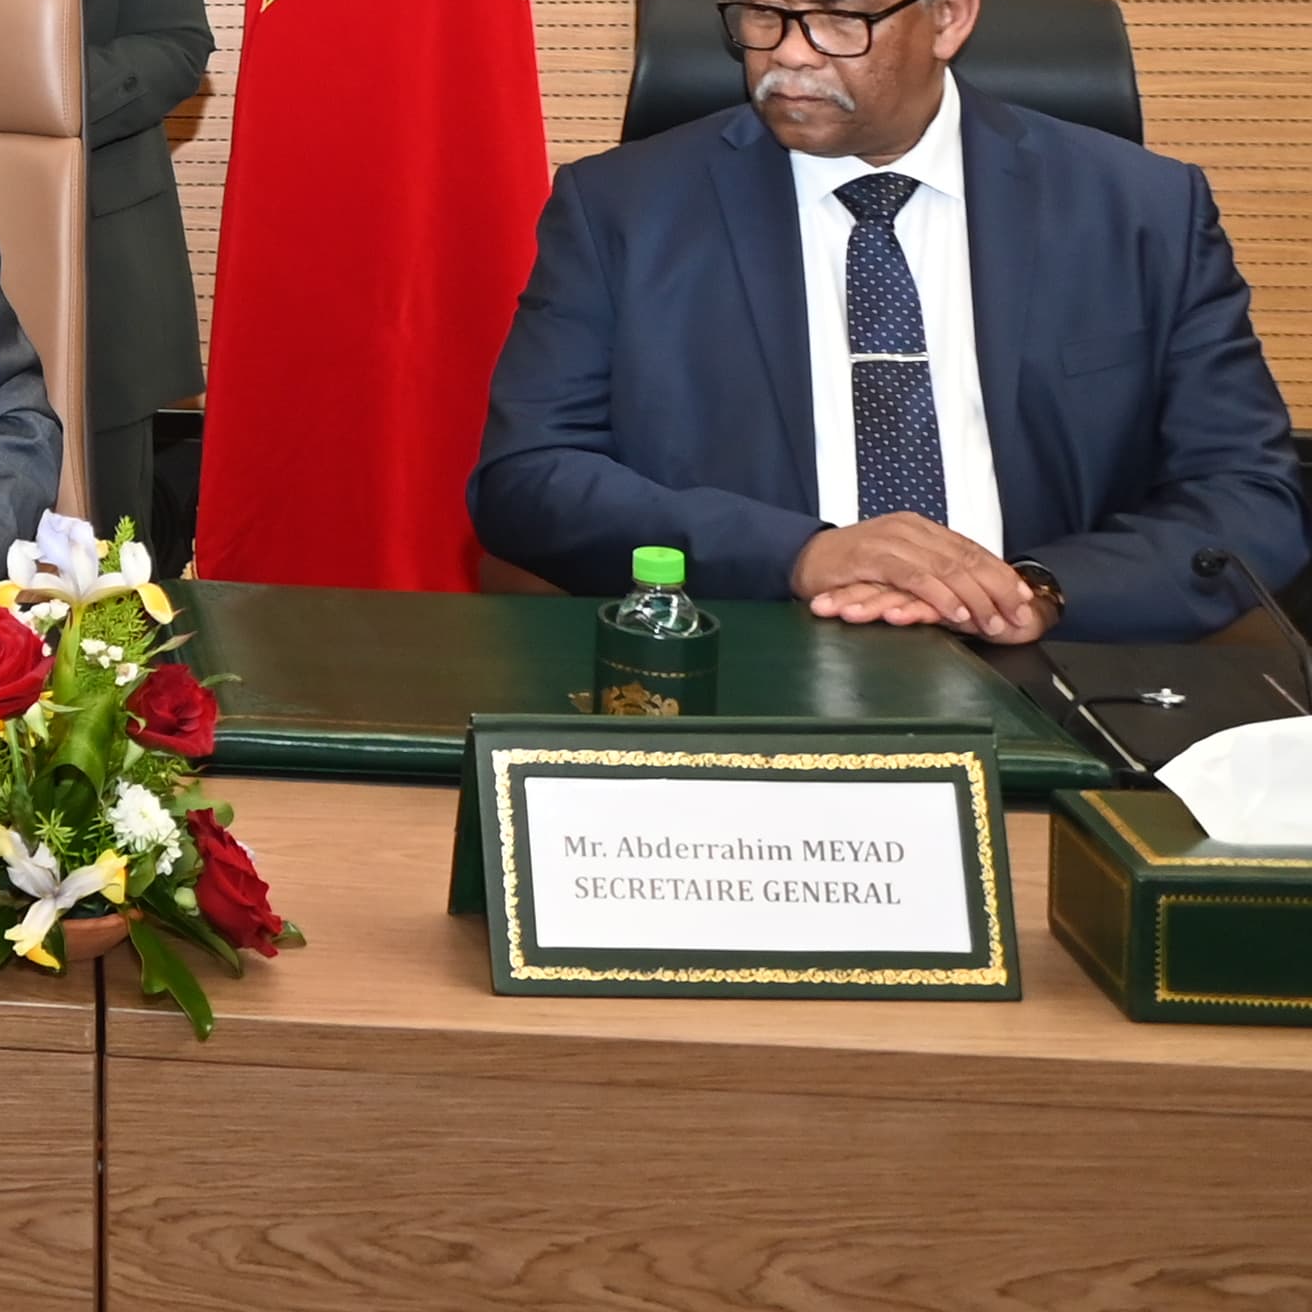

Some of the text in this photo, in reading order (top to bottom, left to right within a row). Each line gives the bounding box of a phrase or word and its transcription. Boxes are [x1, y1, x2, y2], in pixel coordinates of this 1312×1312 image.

[564, 835, 905, 863] Mr. Abderrahim MEYAD
[574, 876, 902, 905] SECRETAIRE GENERAL
